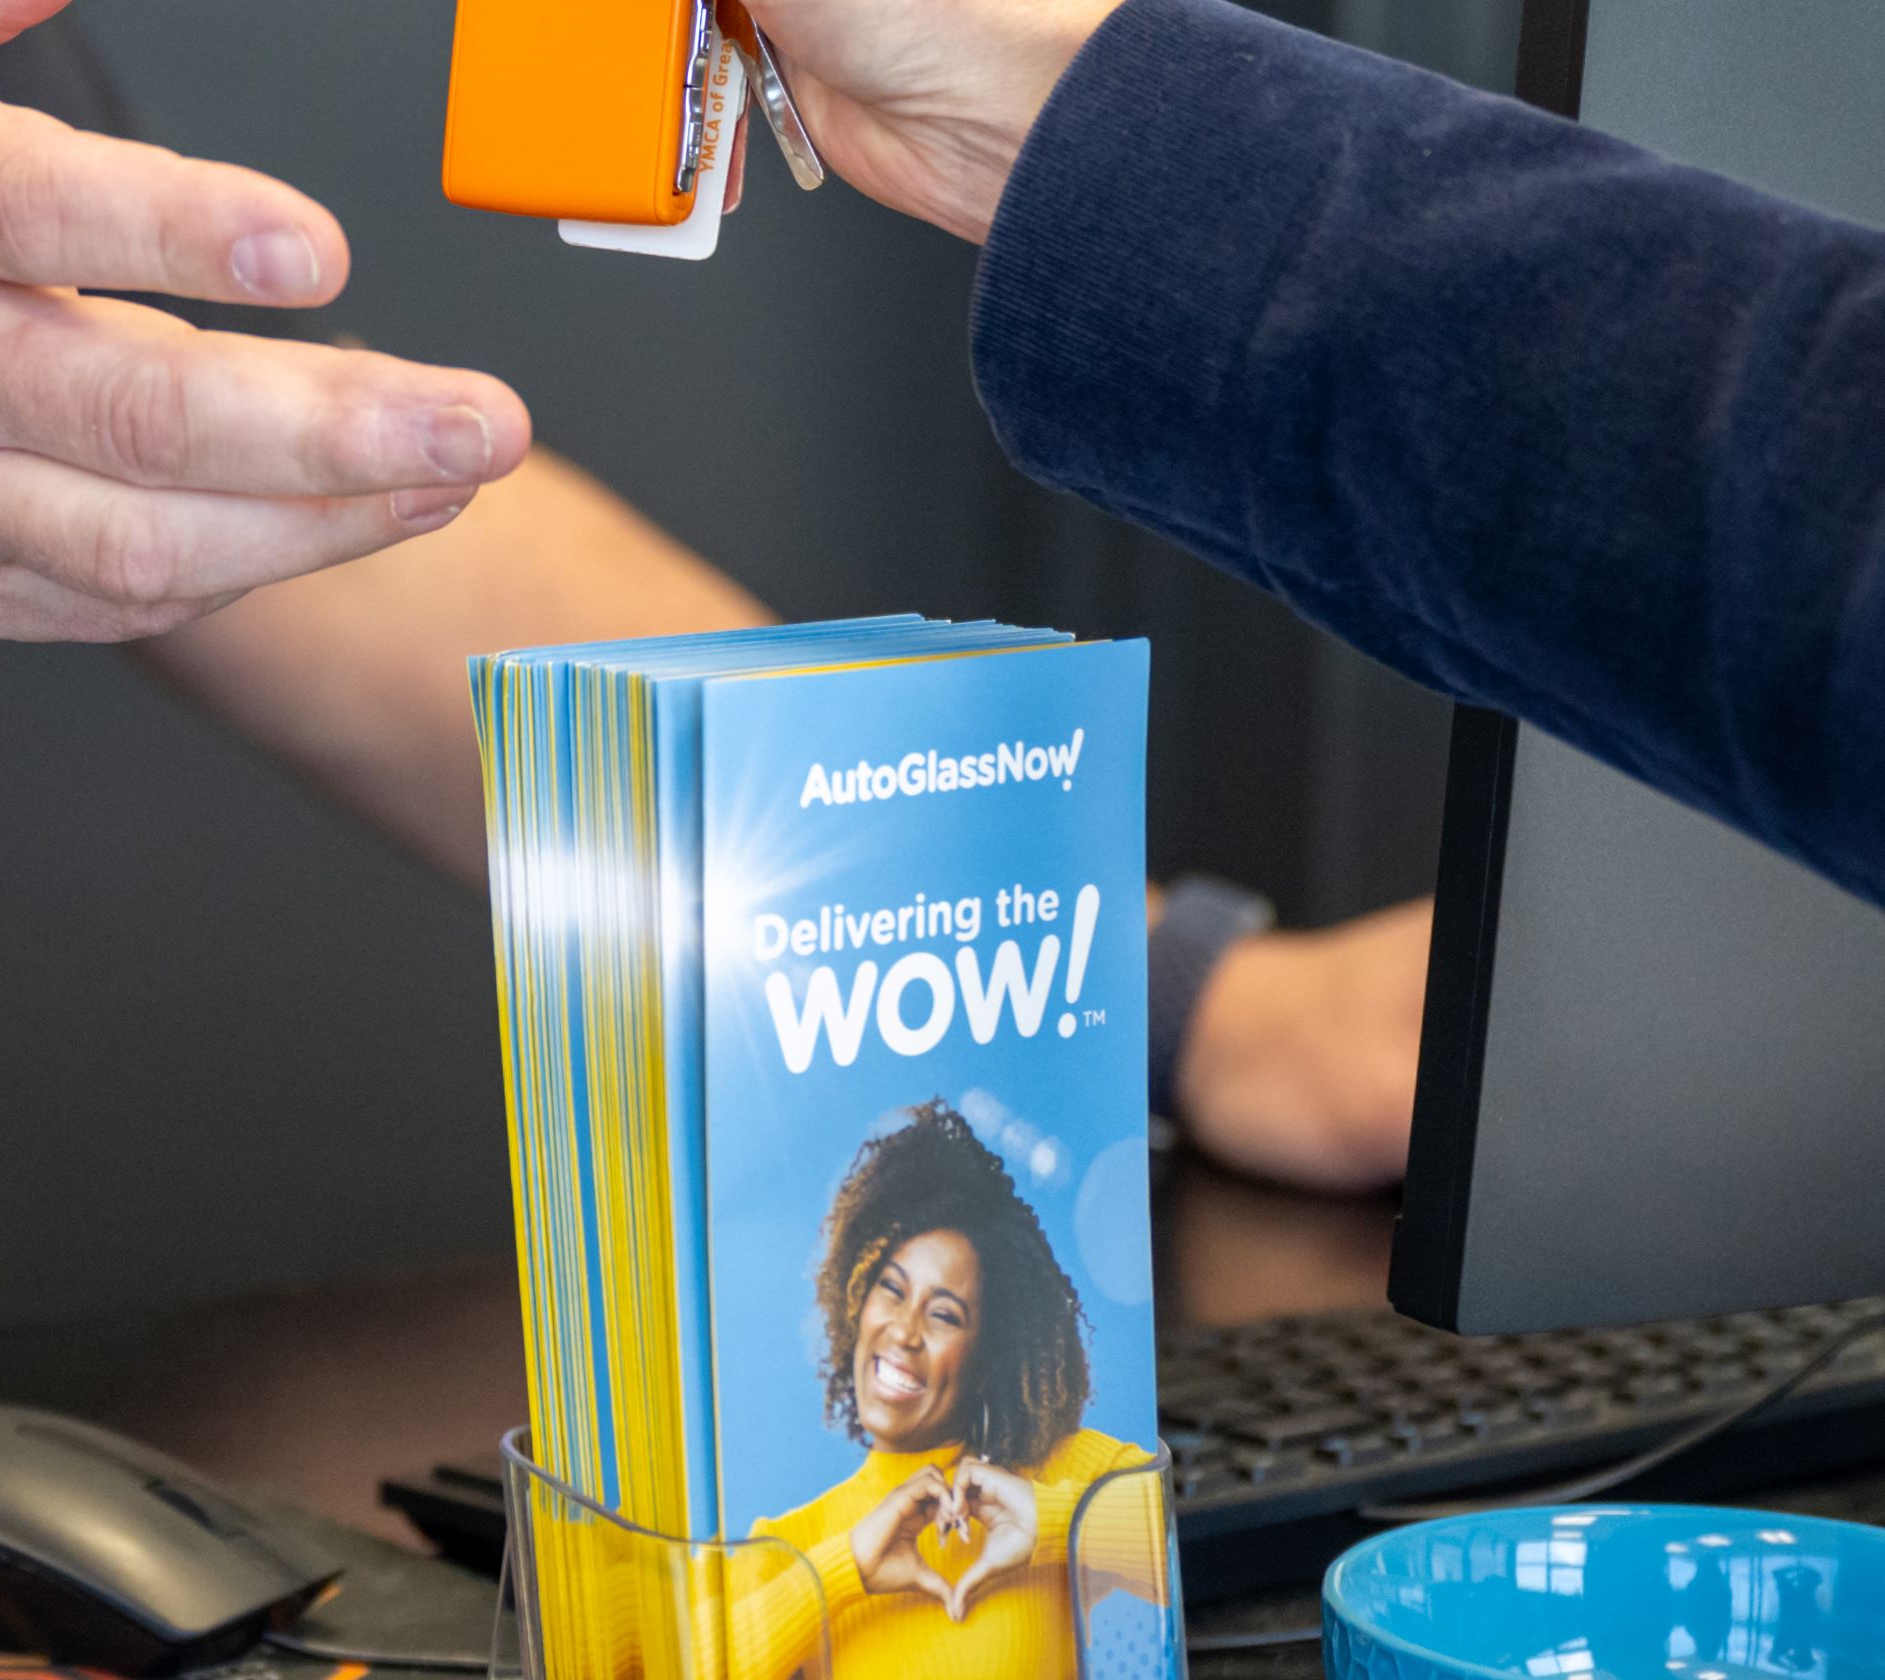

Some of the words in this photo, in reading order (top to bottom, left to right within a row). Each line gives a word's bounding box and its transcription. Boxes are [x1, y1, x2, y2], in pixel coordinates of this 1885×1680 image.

[710, 91, 724, 113] of
[699, 119, 722, 173] YMCA
[799, 728, 1084, 808] AutoGlassNow!
[754, 892, 982, 961] Delivering
[996, 883, 1060, 928] the
[764, 883, 1101, 1075] WOW!
